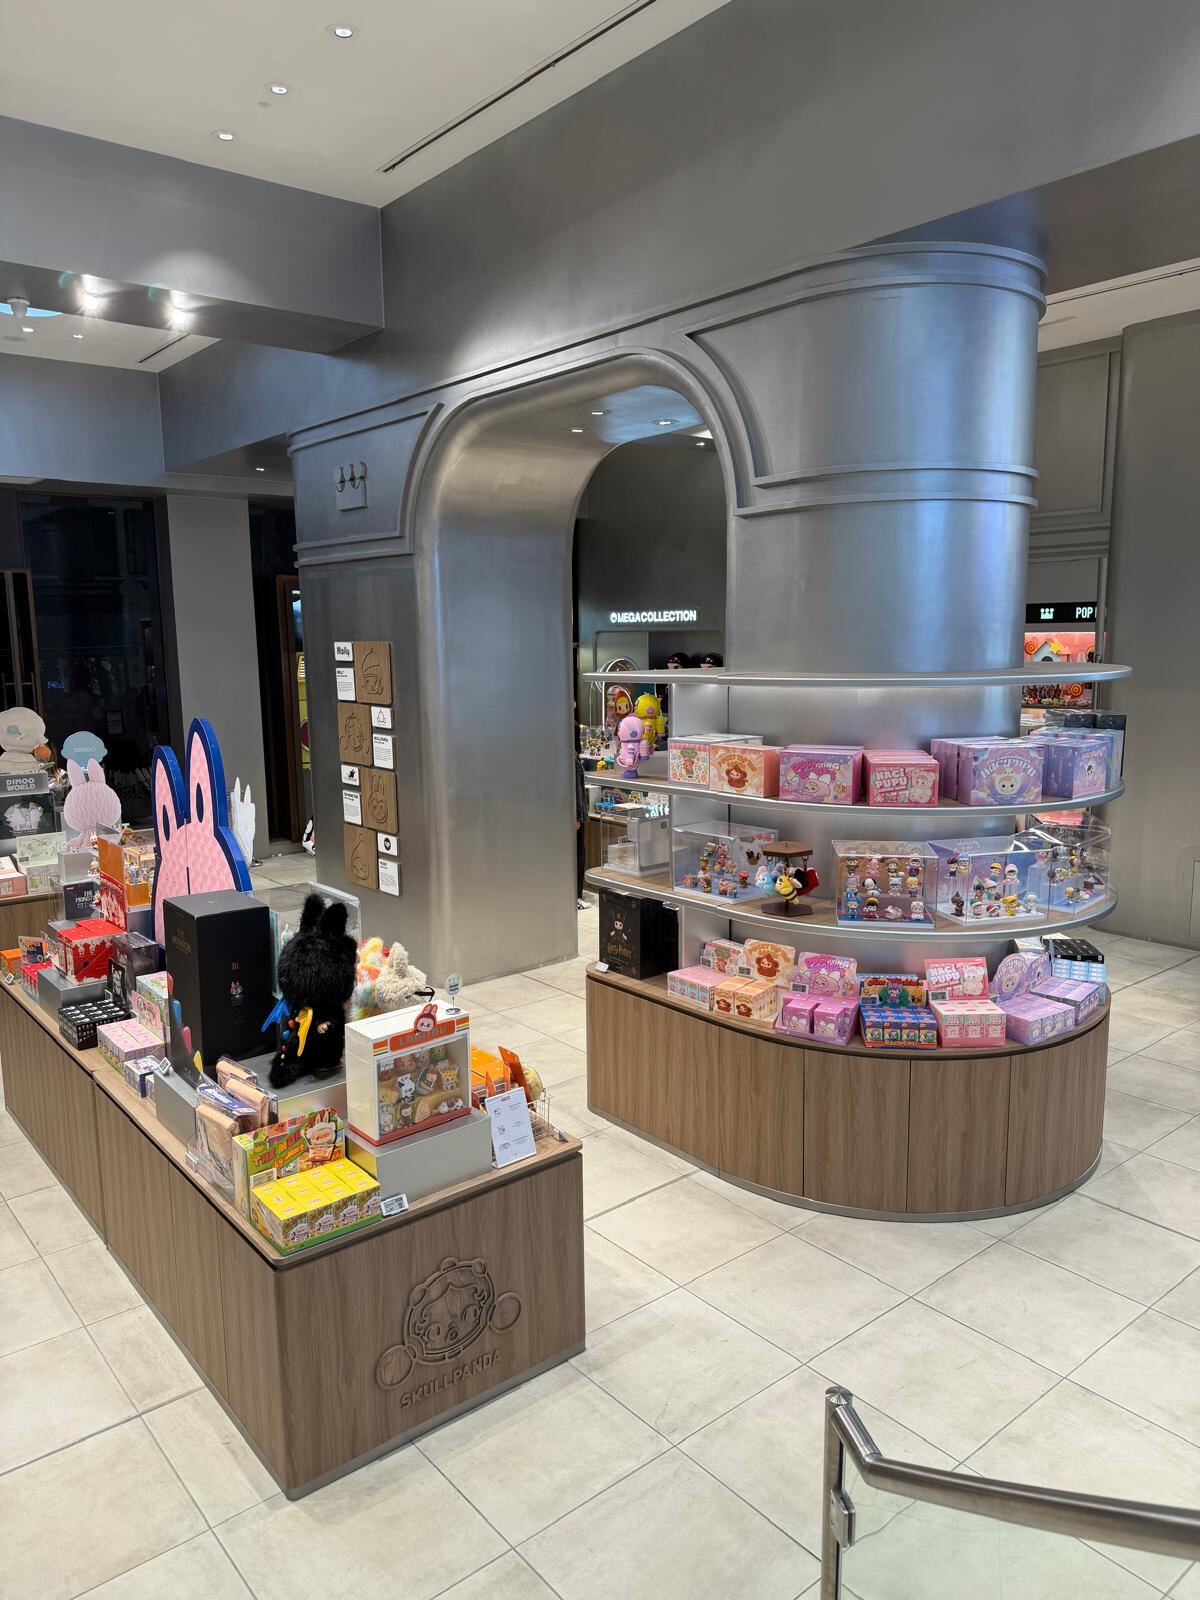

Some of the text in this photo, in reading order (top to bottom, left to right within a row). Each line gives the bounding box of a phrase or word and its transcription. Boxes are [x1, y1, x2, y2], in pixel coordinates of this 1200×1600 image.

[1075, 606, 1093, 619] POP
[336, 646, 350, 658] Molly
[6, 777, 35, 785] DIMOO
[7, 783, 36, 791] WORLD
[875, 776, 908, 789] PUPU
[252, 1149, 276, 1168] THE
[400, 1350, 502, 1408] SKULLPANDA
